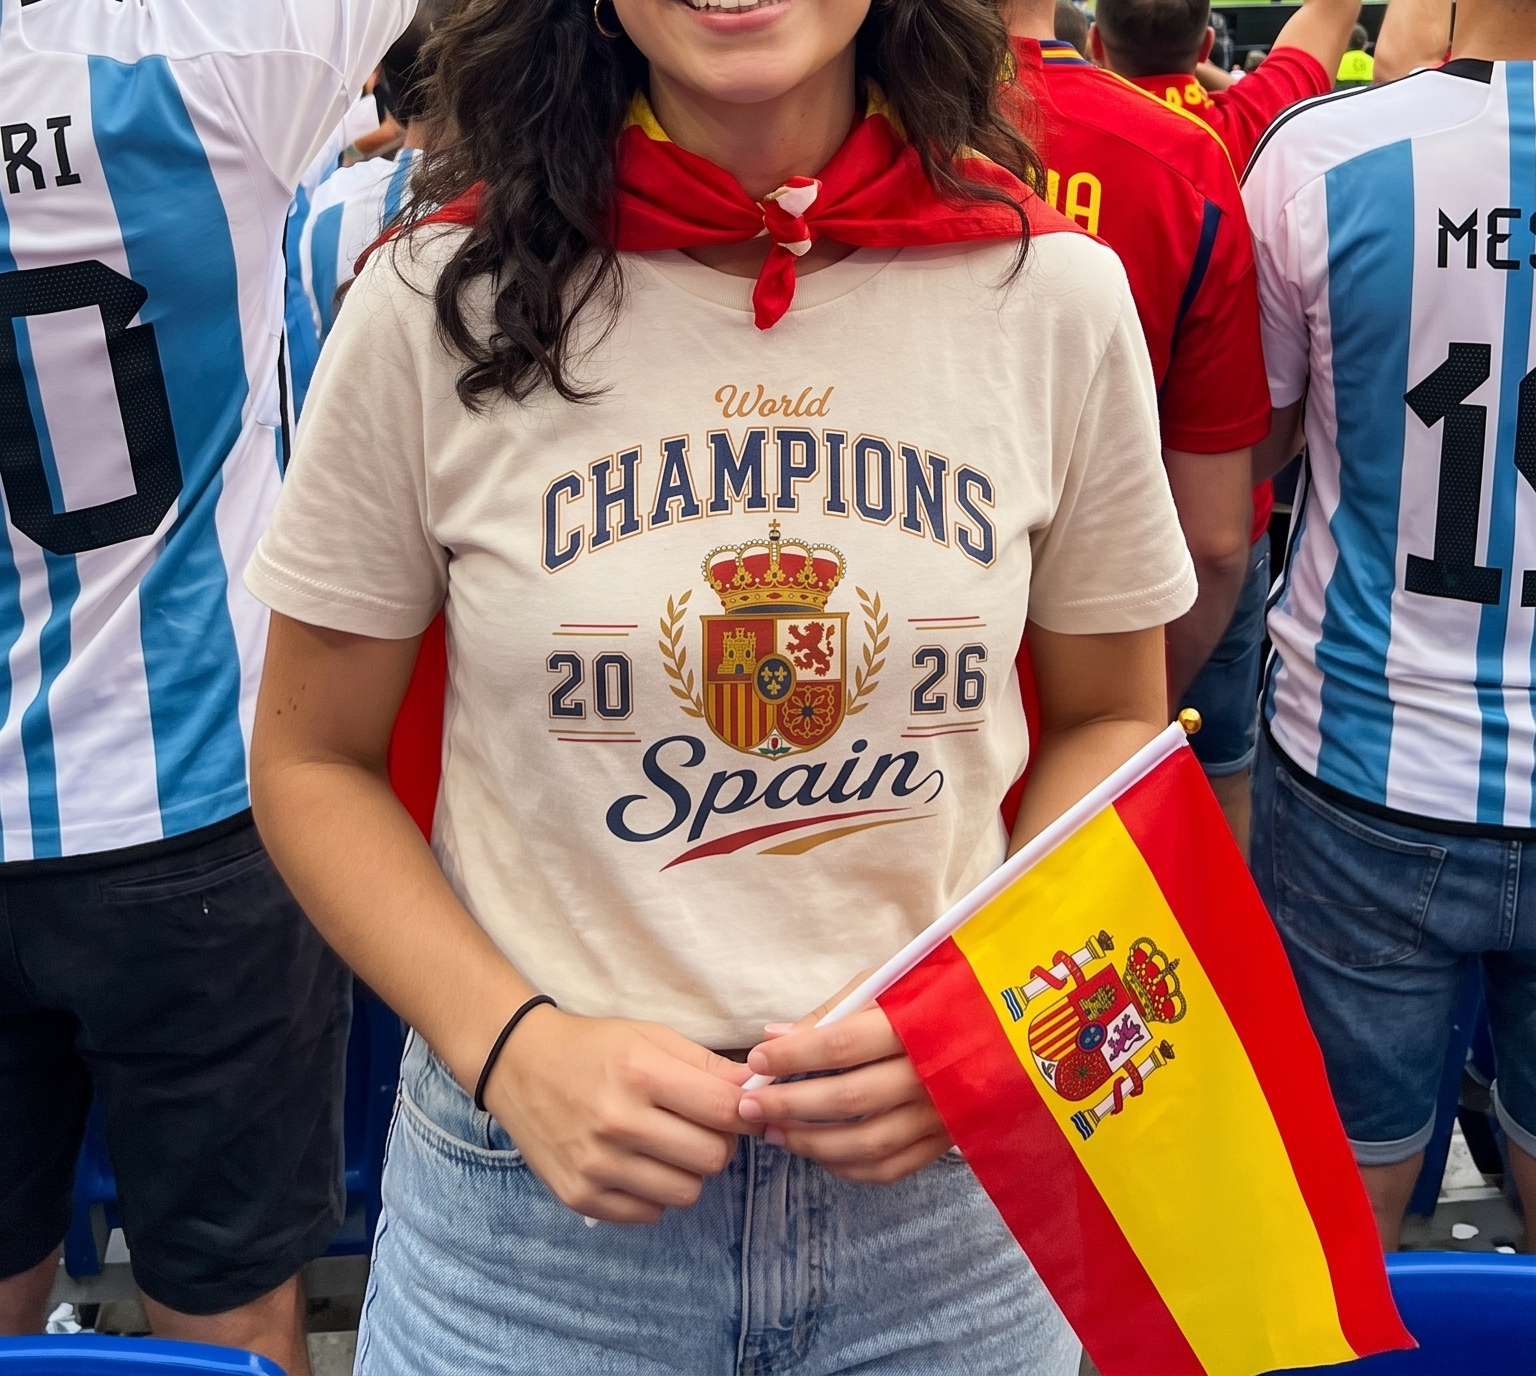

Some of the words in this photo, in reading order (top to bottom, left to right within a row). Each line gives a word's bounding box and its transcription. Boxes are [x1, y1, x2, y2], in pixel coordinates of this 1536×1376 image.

[1, 116, 82, 194] RI
[1437, 207, 1536, 270] ME
[714, 384, 834, 418] World
[541, 426, 996, 574] CHAMPIONS
[546, 650, 634, 721] 20
[910, 642, 988, 715] 26
[605, 735, 944, 843] Spain
